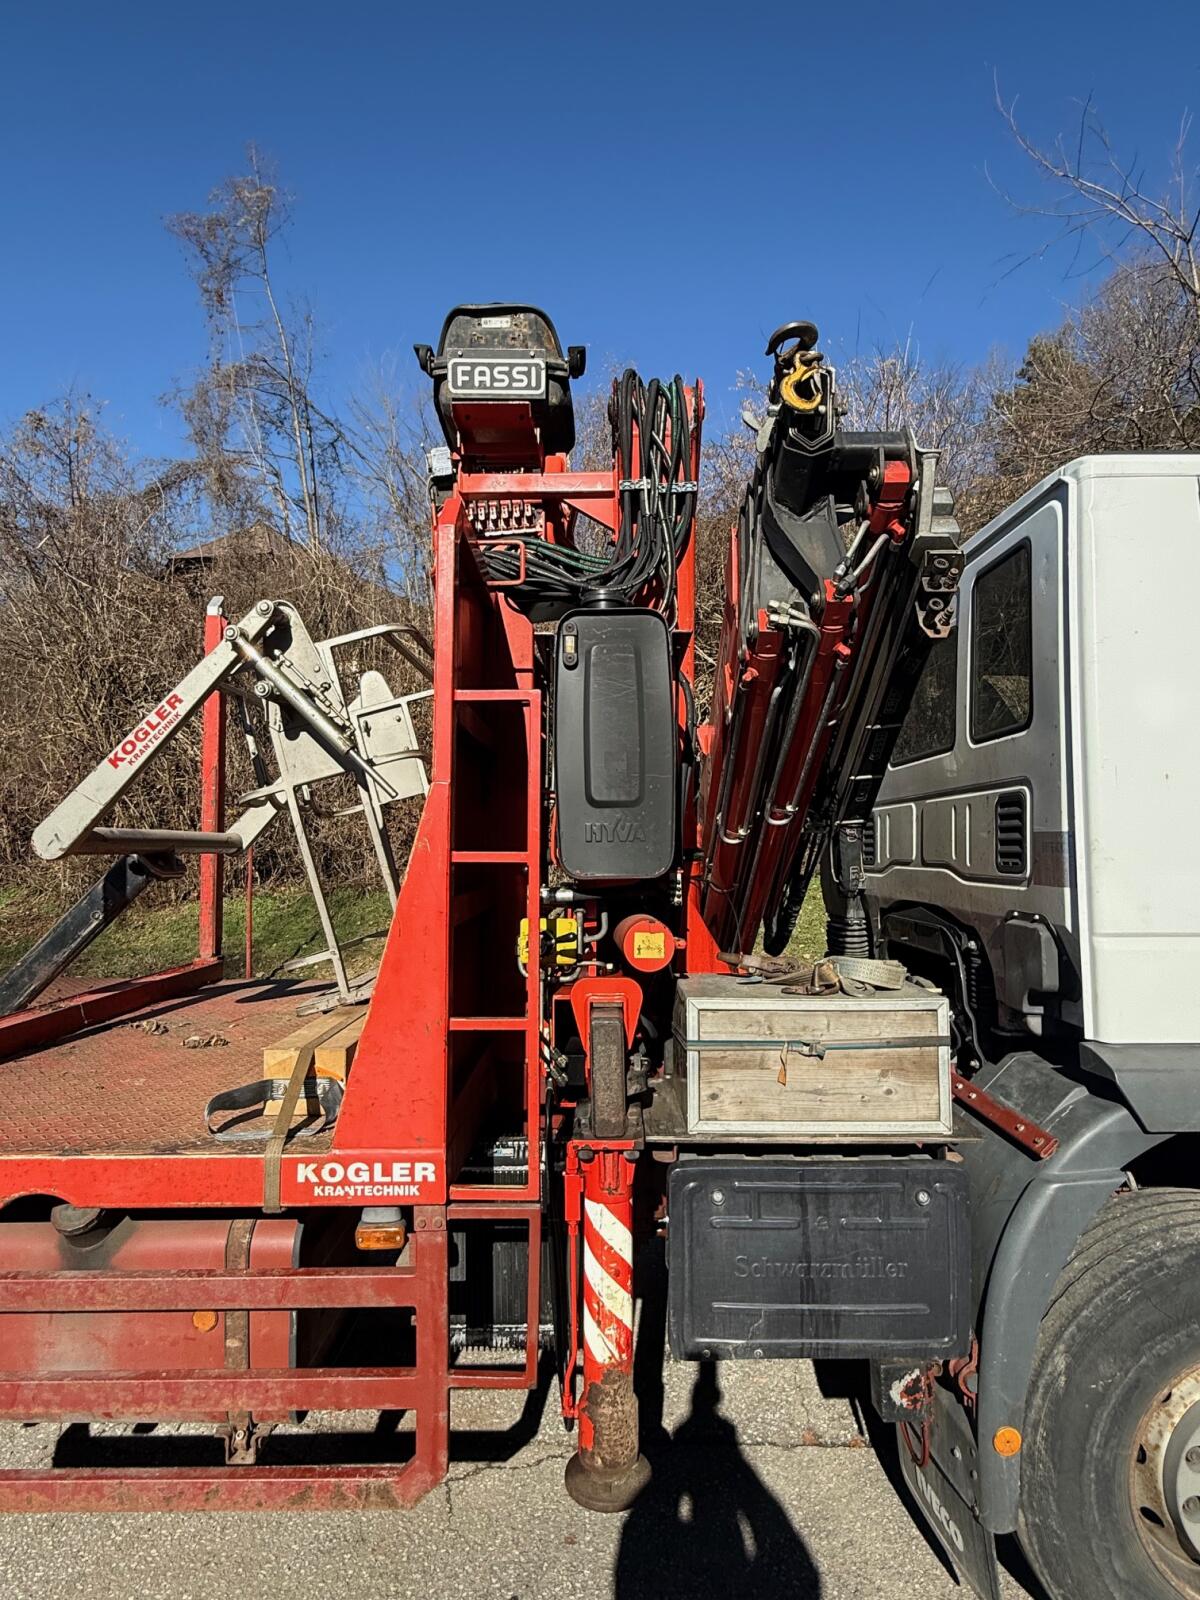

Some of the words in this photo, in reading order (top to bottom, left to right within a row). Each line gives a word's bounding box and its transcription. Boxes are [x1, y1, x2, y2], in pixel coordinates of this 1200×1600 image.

[456, 366, 537, 388] FASSI
[107, 693, 184, 769] KOGLER
[584, 821, 647, 843] HYVA
[296, 1162, 436, 1183] KOGLER
[313, 1185, 420, 1197] KRANTECHNIK
[734, 1255, 909, 1279] Schwarzmüller
